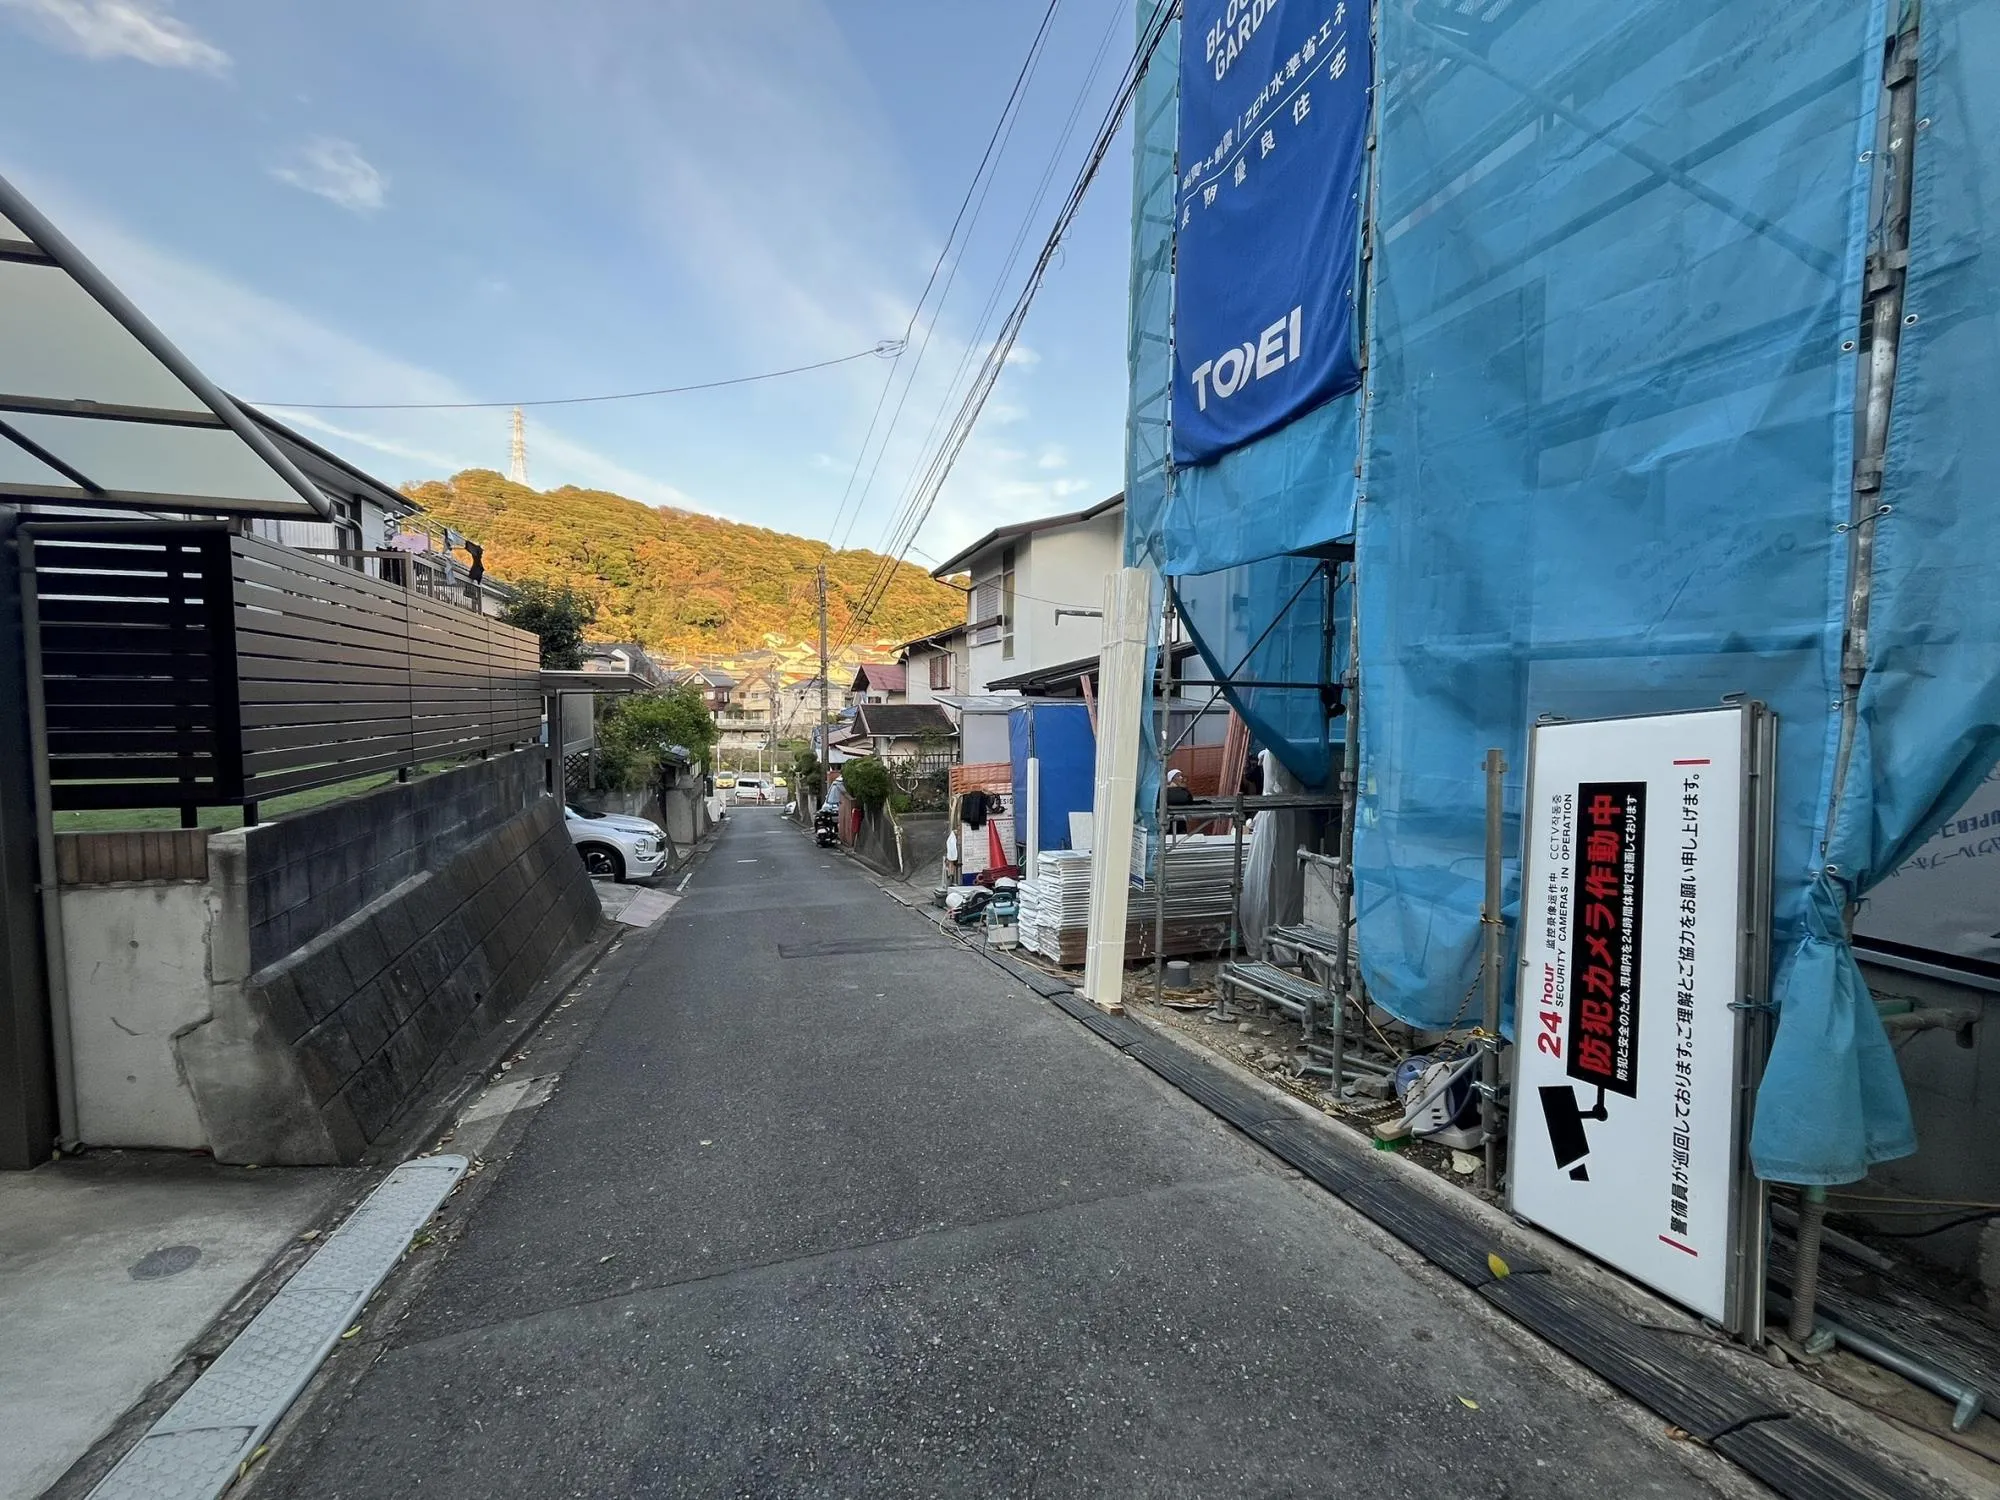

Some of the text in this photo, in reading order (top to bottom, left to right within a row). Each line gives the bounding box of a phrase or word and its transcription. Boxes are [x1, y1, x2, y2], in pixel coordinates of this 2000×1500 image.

[1182, 46, 1347, 230] 長期優良住宅
[1555, 794, 1572, 1008] SECURITY CAMERAS IN OPERATION
[1579, 795, 1621, 1076] 防犯カメラ作動中
[1537, 963, 1563, 1058] 24 hour
